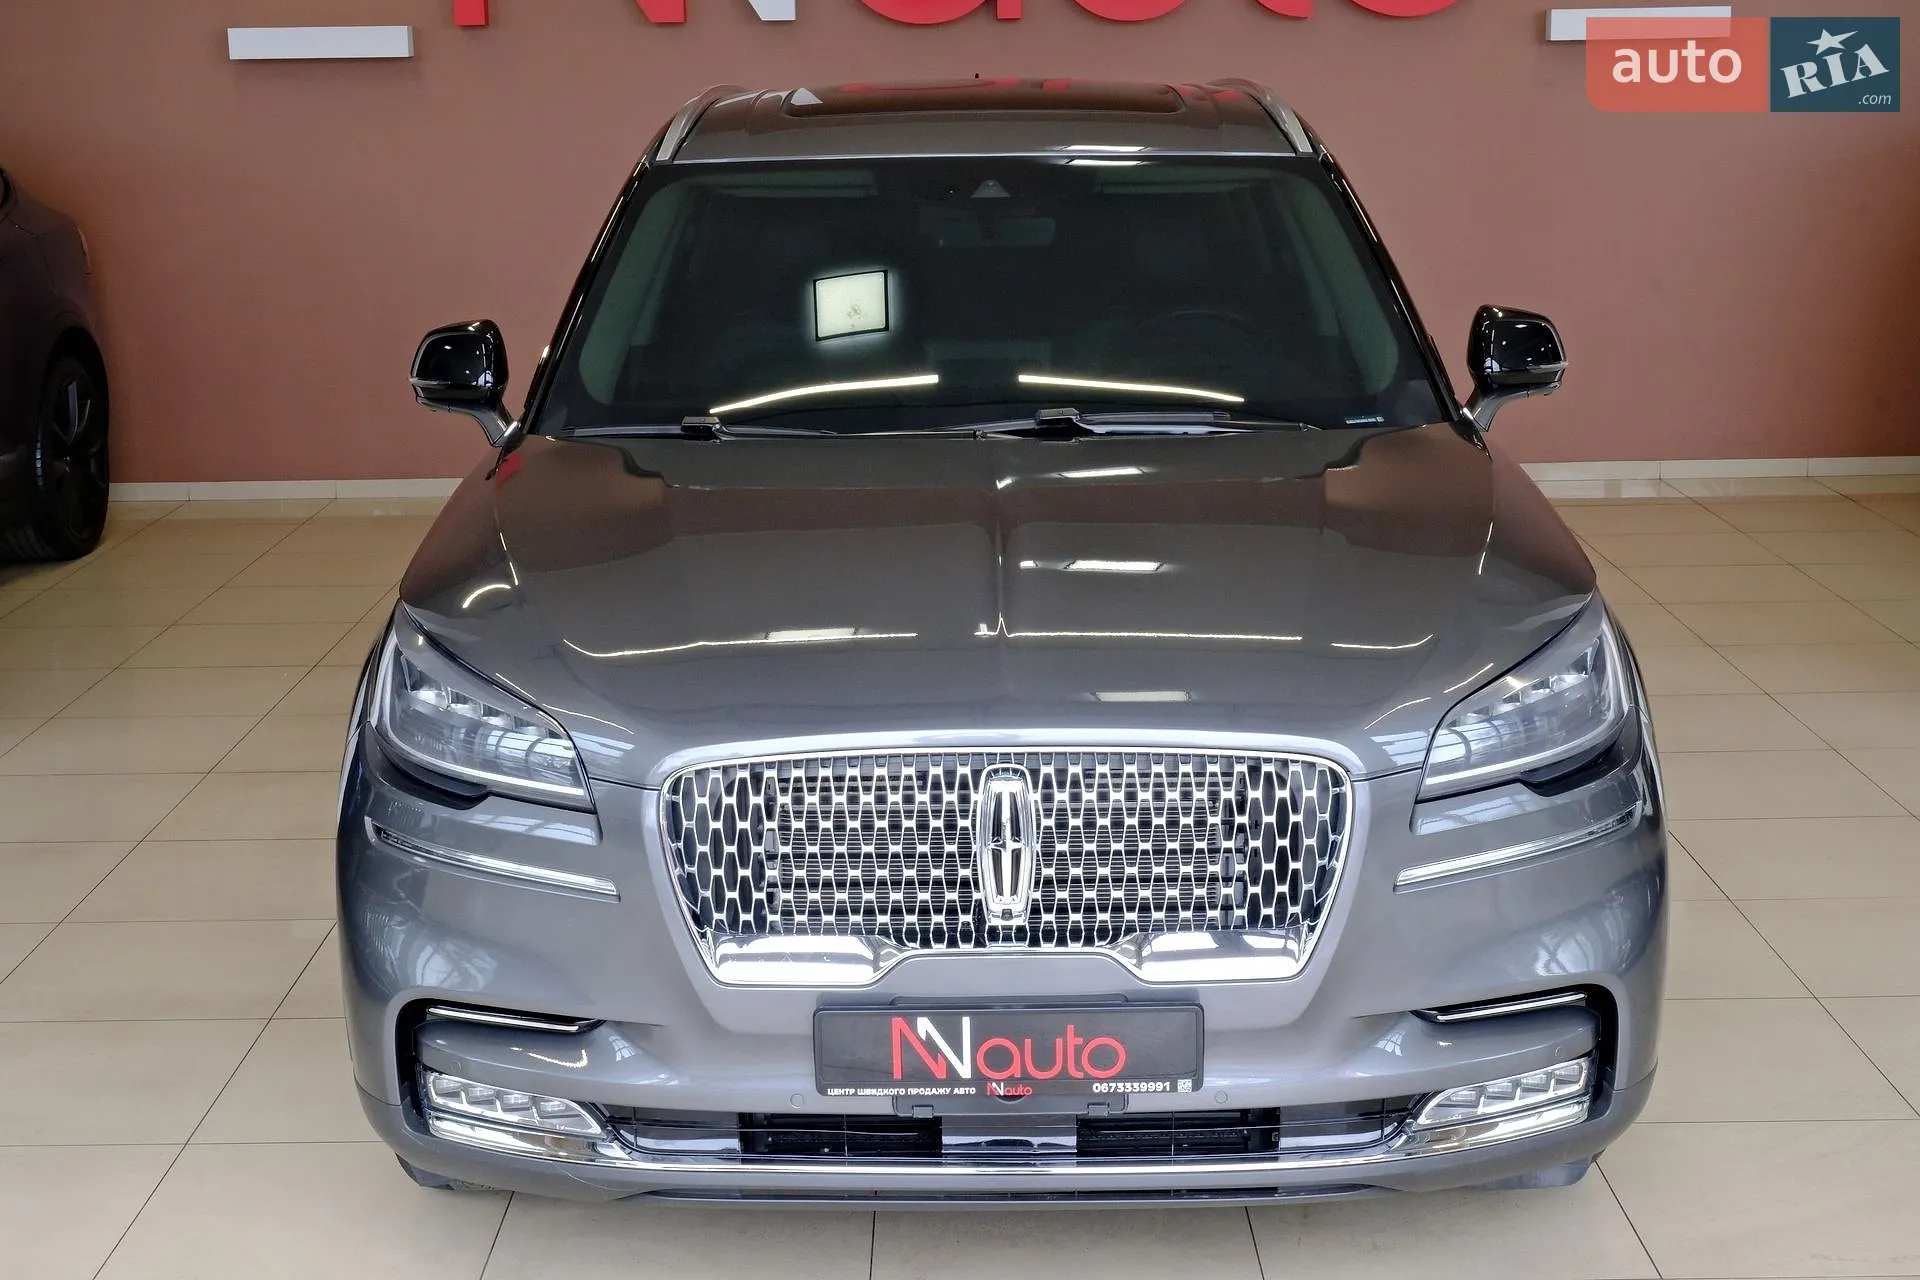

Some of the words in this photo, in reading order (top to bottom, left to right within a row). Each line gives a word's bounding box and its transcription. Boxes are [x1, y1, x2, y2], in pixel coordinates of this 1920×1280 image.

[827, 1088, 855, 1096] ЦЕНТР
[857, 1087, 905, 1096] ШВИДКОГО
[907, 1087, 951, 1096] ПРОДАЖУ
[953, 1087, 976, 1095] АВТО
[1092, 1082, 1171, 1093] 0673339991
